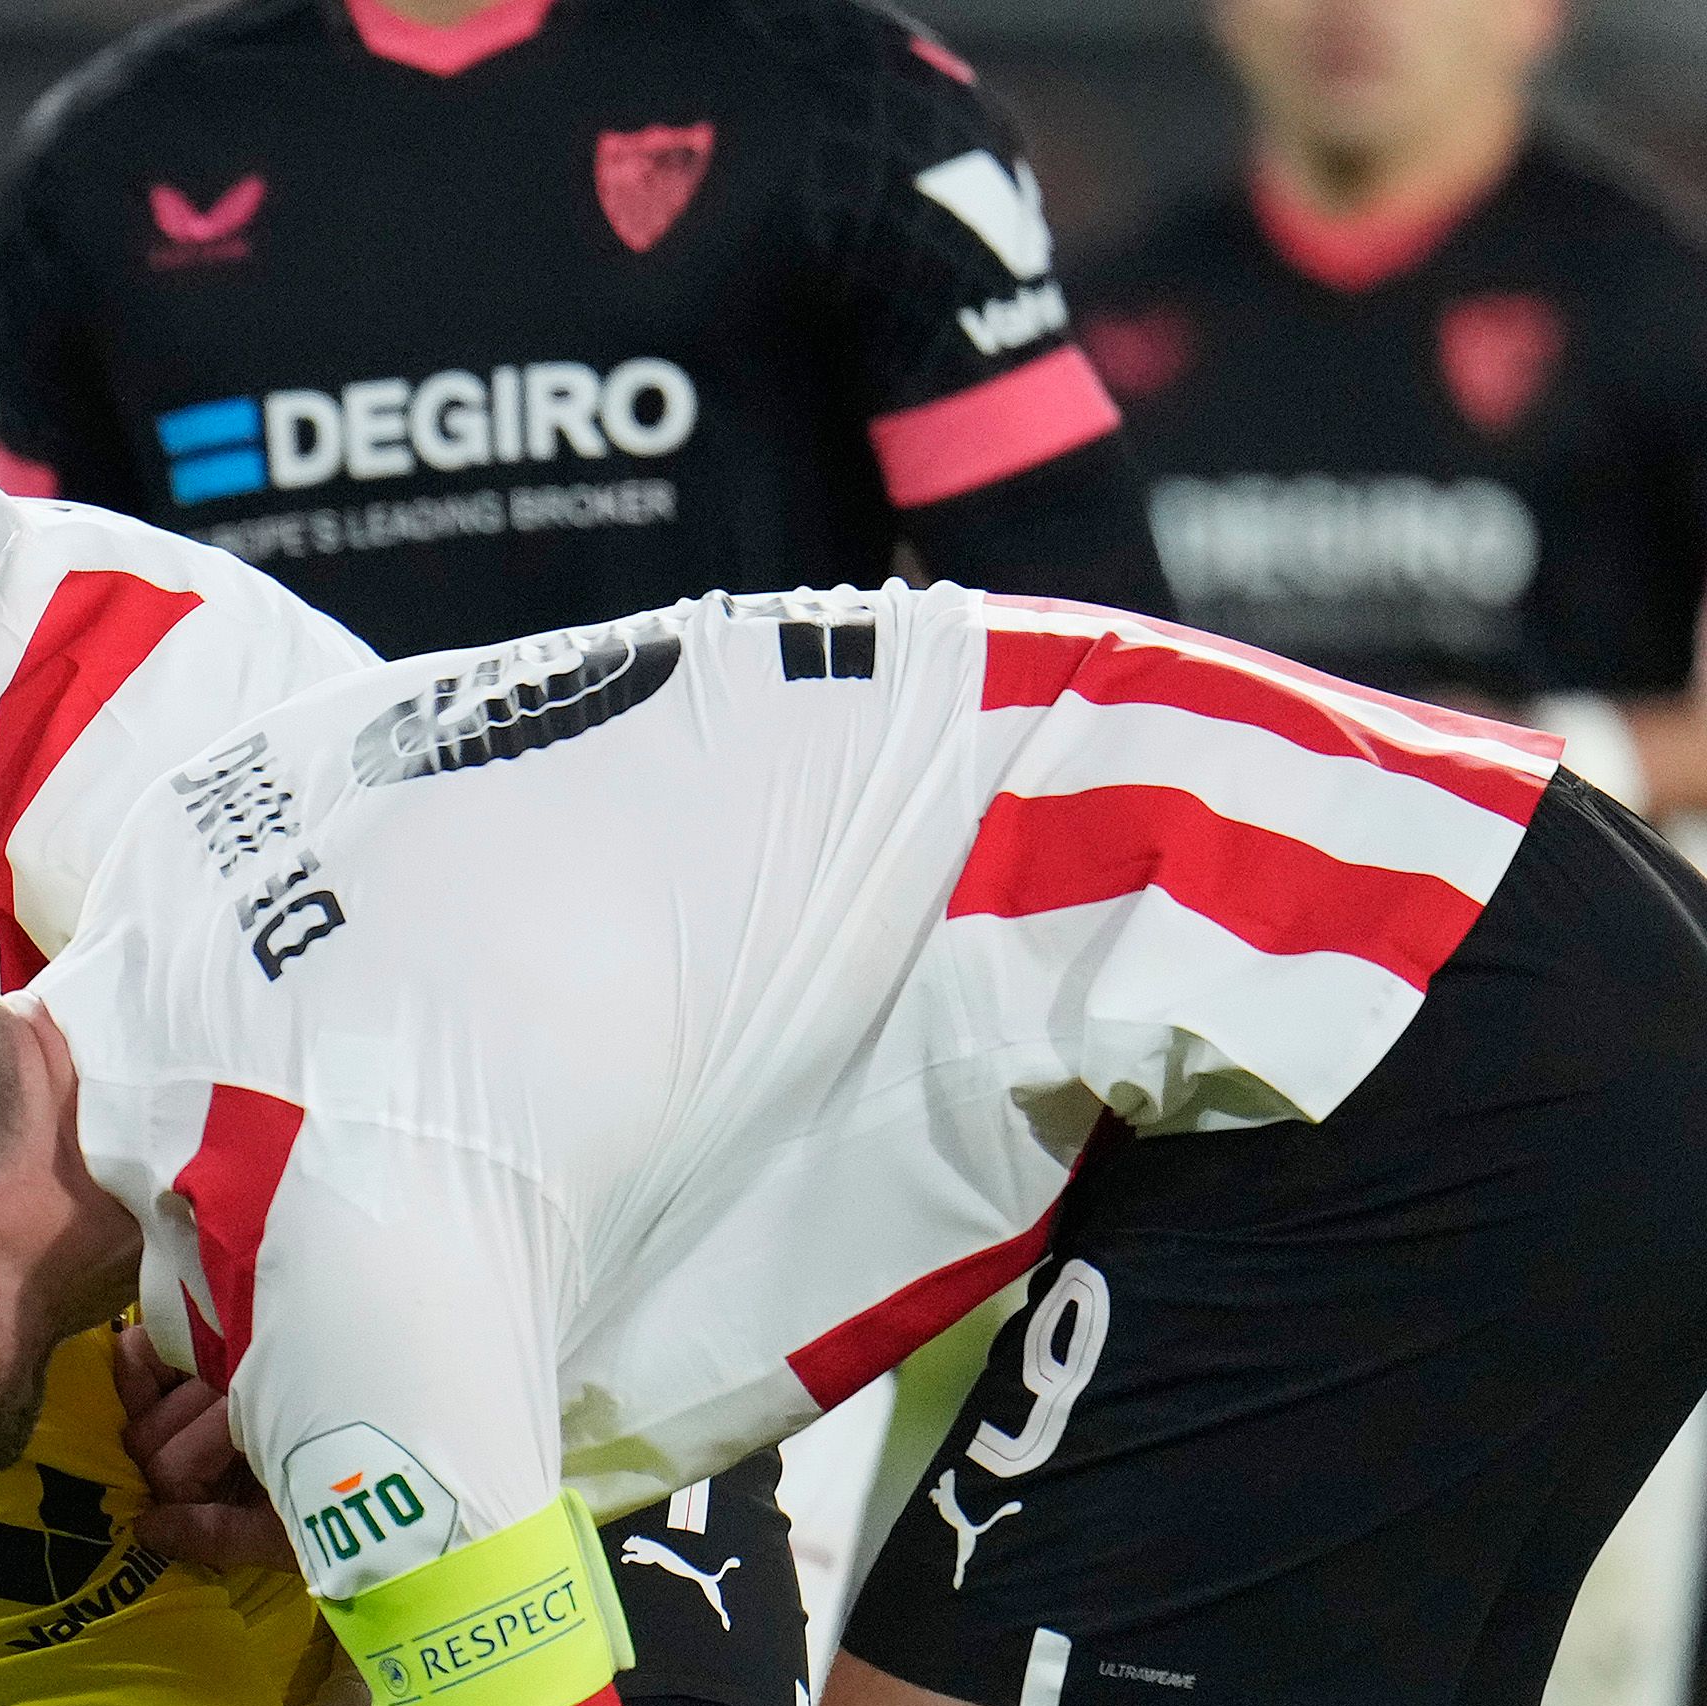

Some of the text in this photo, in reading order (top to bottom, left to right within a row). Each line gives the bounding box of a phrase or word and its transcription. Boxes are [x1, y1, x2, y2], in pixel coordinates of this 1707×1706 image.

[265, 357, 697, 490] DEGIRO
[965, 1258, 1111, 1478] 9
[303, 1472, 425, 1568] TOTO
[419, 1580, 577, 1680] RESPECT
